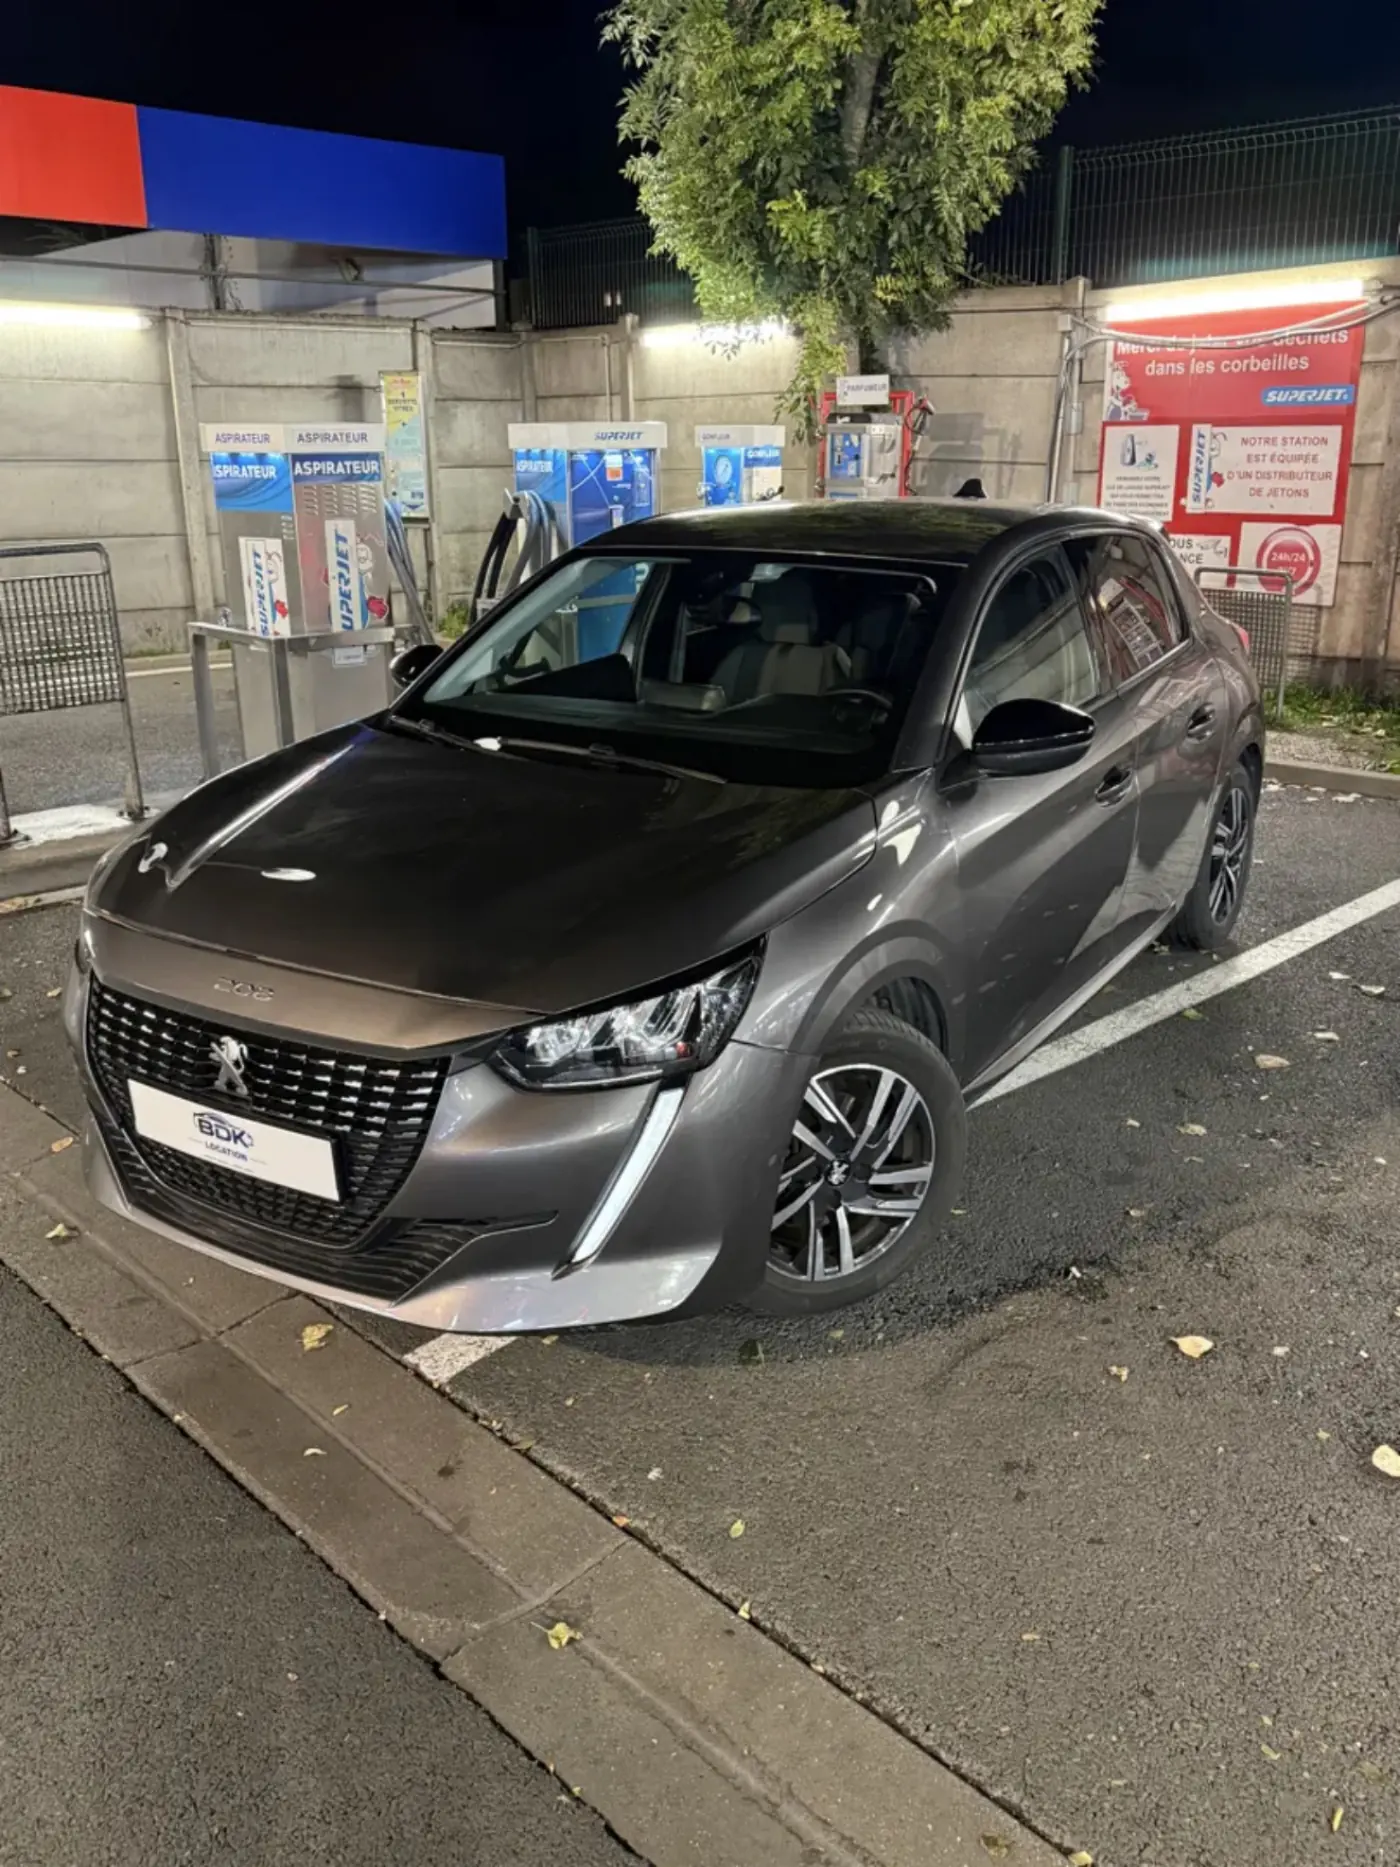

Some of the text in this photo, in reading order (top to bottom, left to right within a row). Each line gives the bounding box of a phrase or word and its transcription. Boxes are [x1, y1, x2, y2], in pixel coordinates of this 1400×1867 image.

[1145, 353, 1309, 376] dans les corbeilles
[1266, 388, 1344, 403] SUPERJET
[215, 433, 270, 444] ASPIRATEUR
[297, 432, 368, 443] ASPIRATEUR
[595, 431, 643, 441] SUPERJET
[1240, 436, 1328, 446] NOTRE STATION
[1246, 451, 1320, 464] EST ÉQUIPÉE
[214, 465, 276, 480] SPIRATEUR
[294, 460, 379, 475] ASPIRATEUR
[1191, 431, 1206, 503] SUPERJET
[1226, 470, 1333, 481] D'UN DISTRIBUTEUR
[1249, 487, 1309, 498] DE JETONS
[335, 529, 354, 631] UPERJET
[198, 1118, 249, 1149] BDK
[205, 1141, 248, 1163] LOCATION
